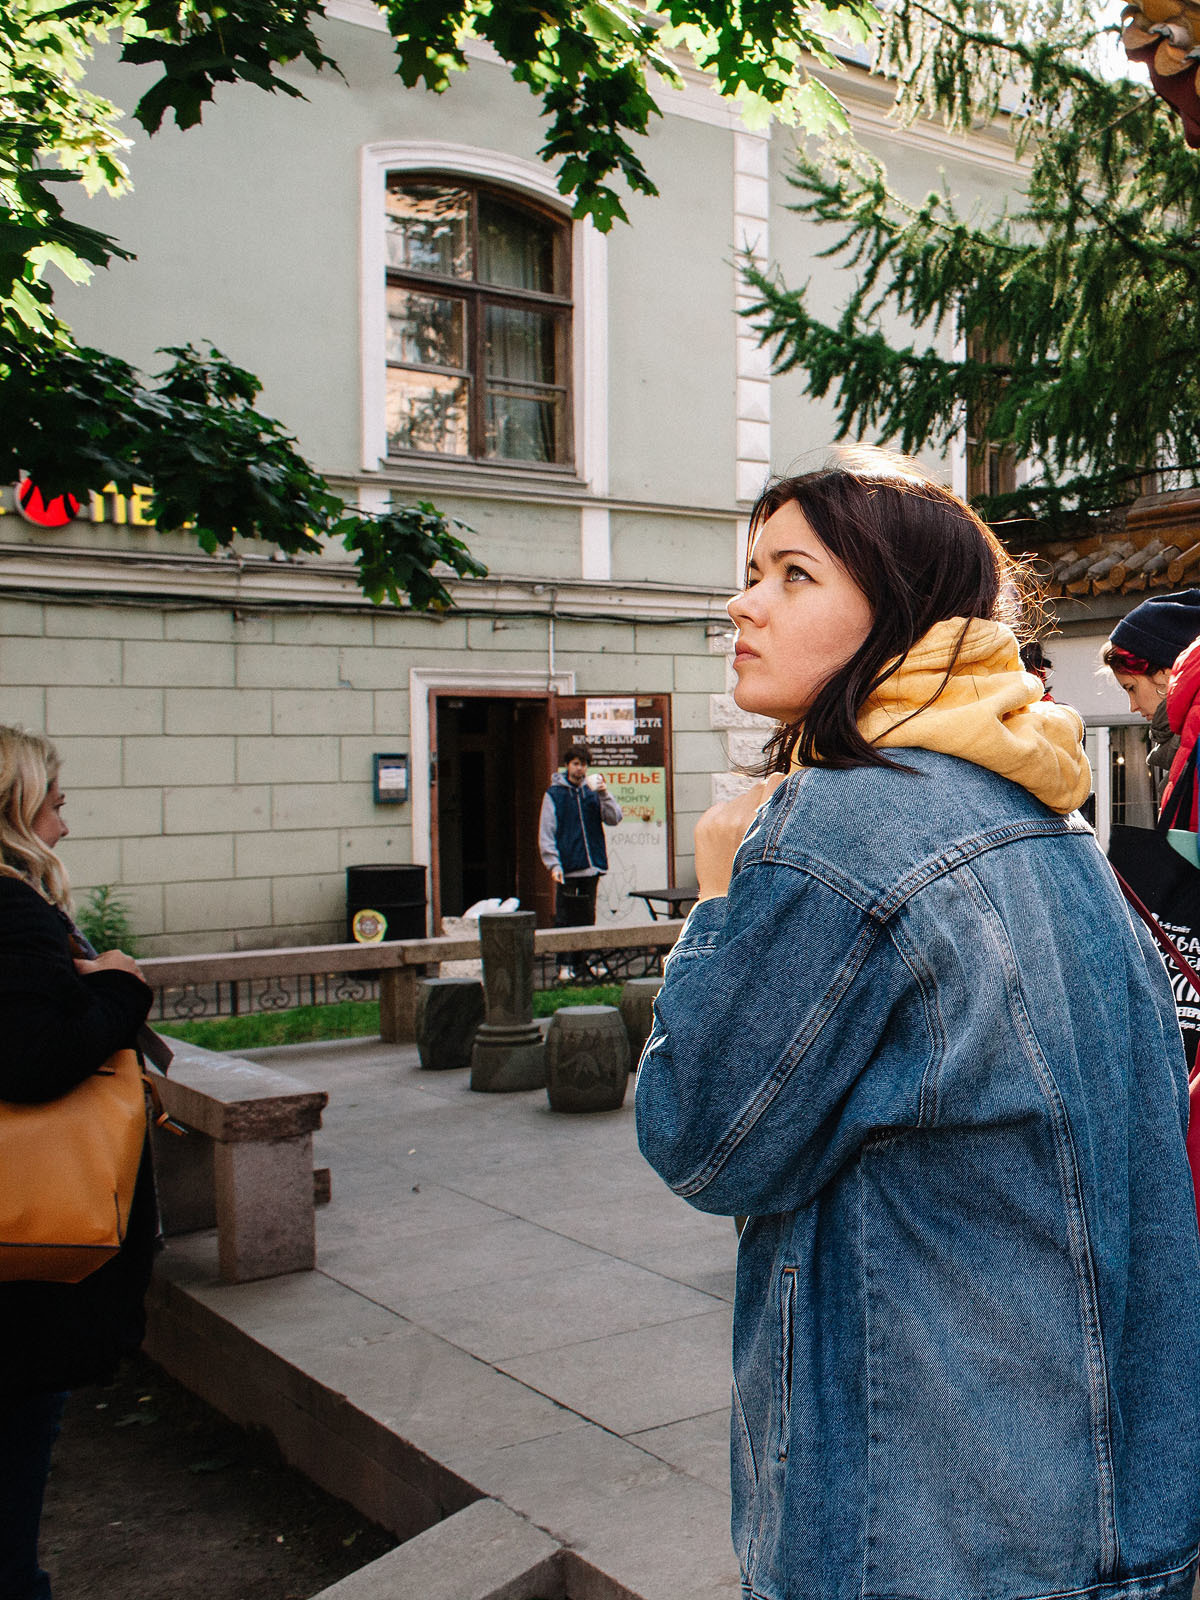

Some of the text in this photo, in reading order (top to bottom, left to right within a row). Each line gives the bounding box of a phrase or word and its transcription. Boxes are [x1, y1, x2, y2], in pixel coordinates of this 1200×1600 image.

[620, 786, 635, 794] ПО
[616, 794, 651, 803] МОНТУ
[621, 806, 655, 817] ЕЖДЫ
[610, 832, 661, 846] КРАСОТЫ
